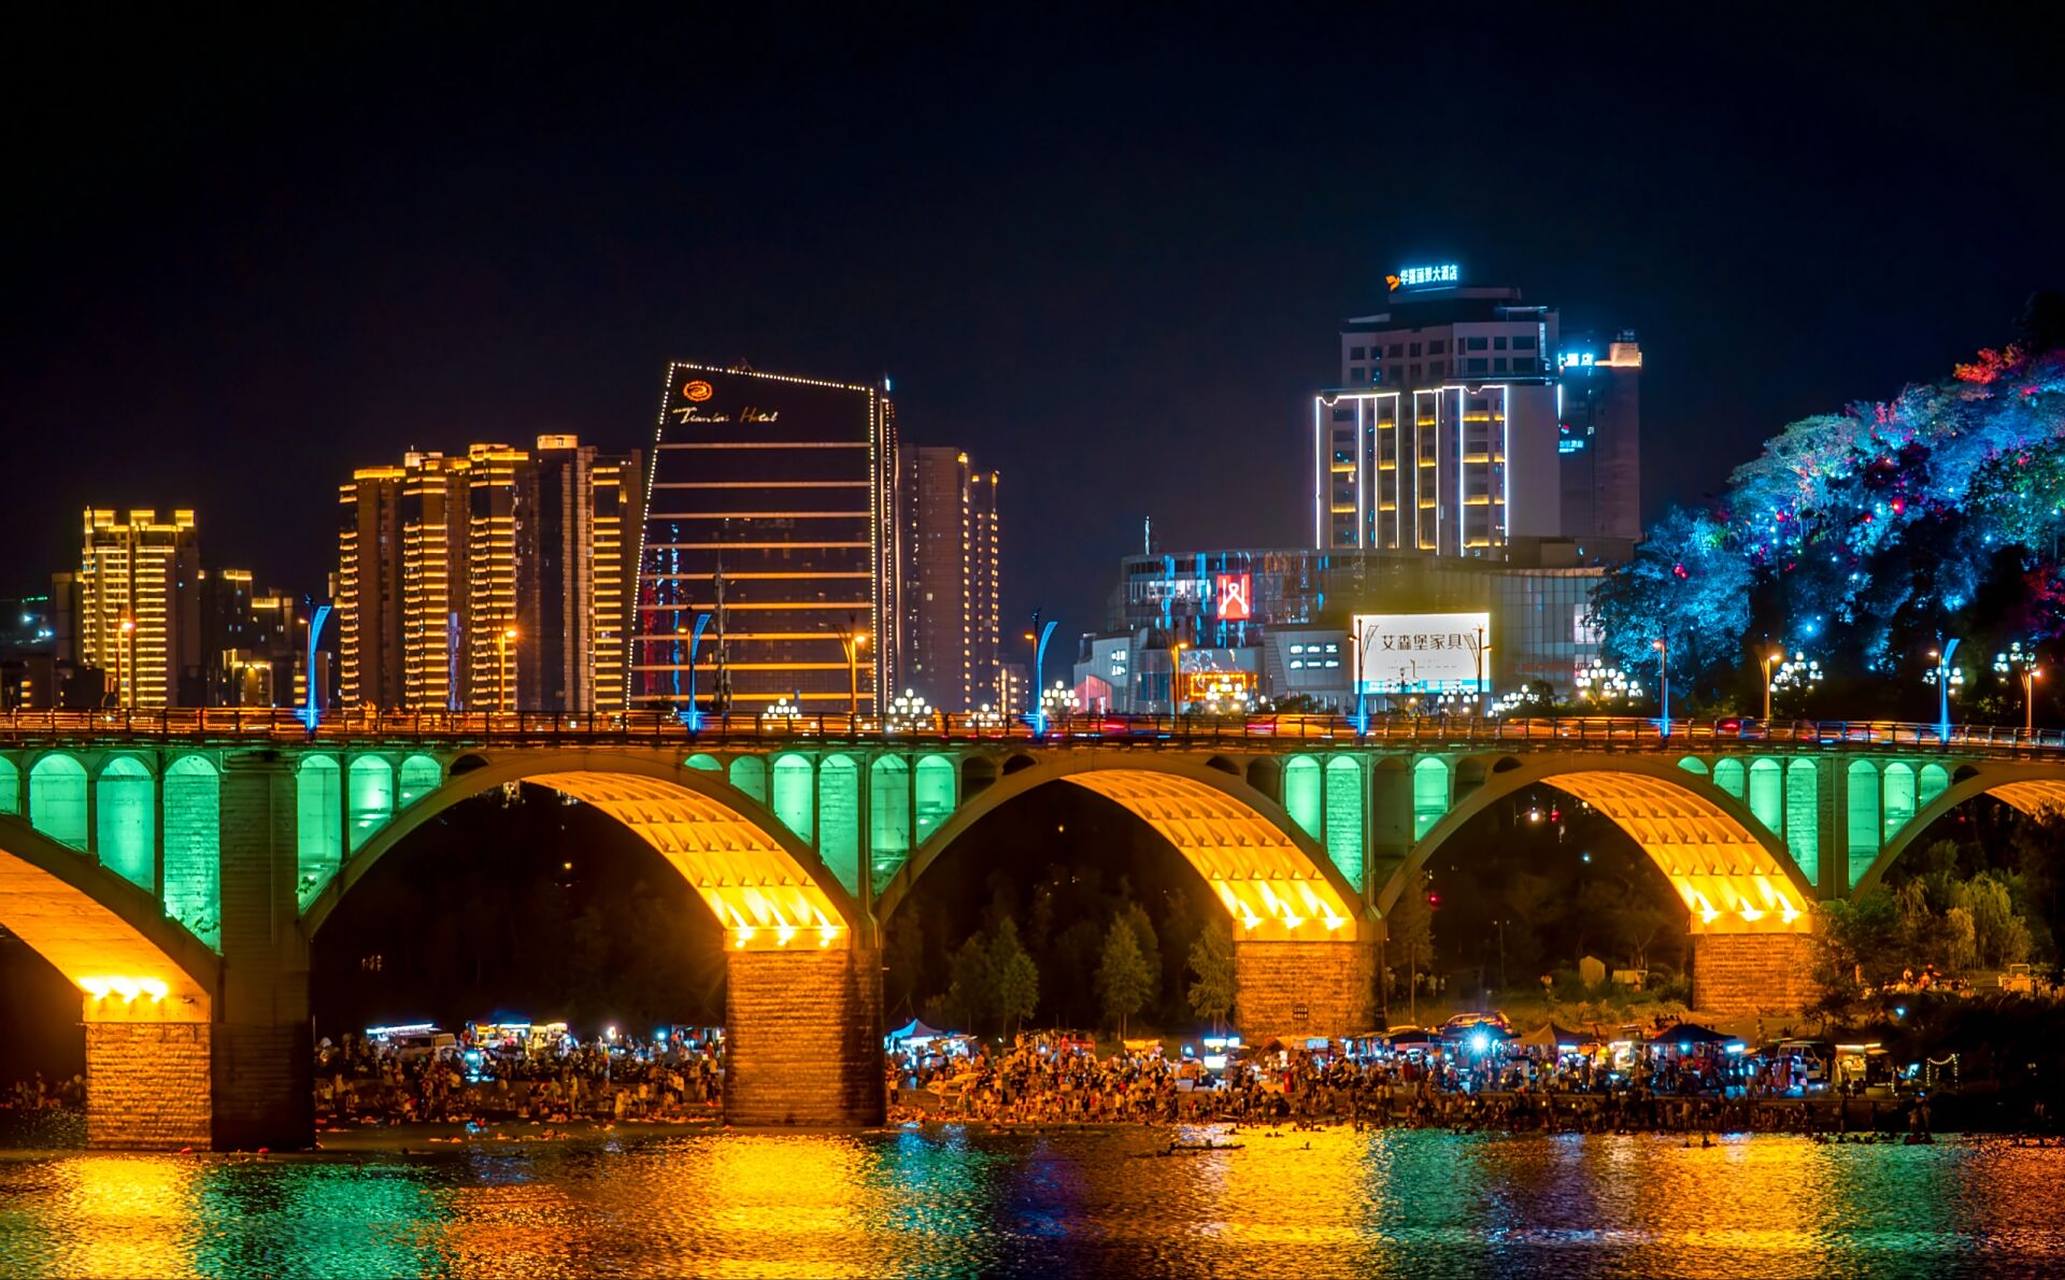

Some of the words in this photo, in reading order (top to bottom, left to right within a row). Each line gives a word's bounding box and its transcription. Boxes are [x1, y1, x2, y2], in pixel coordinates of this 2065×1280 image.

[1381, 633, 1463, 651] 艾森堡家具
